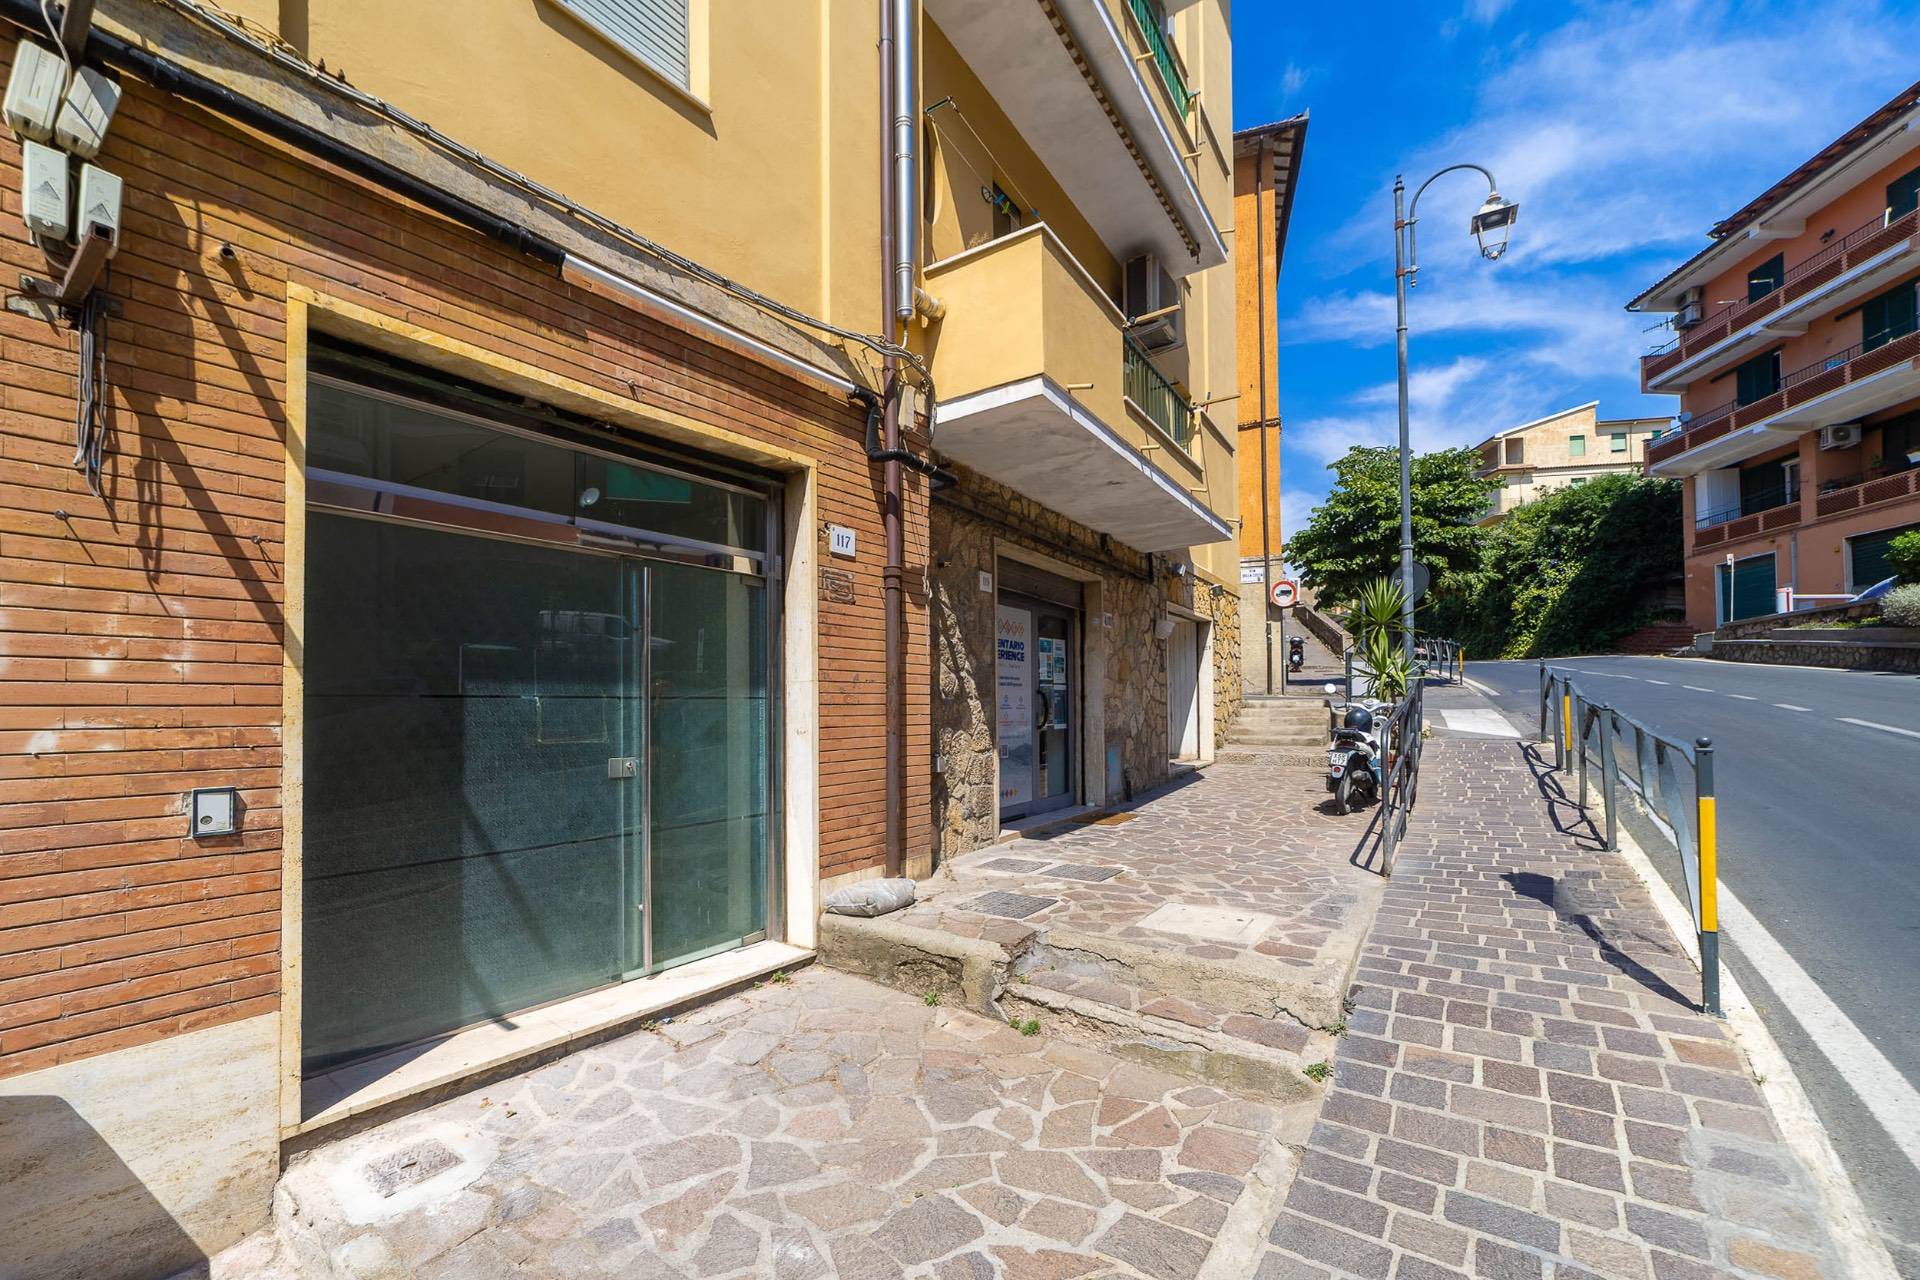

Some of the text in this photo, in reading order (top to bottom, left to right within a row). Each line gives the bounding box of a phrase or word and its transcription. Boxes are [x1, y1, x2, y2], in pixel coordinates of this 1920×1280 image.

[837, 533, 851, 549] 117
[998, 638, 1025, 651] ENTARIO
[998, 650, 1025, 662] ERIENCE
